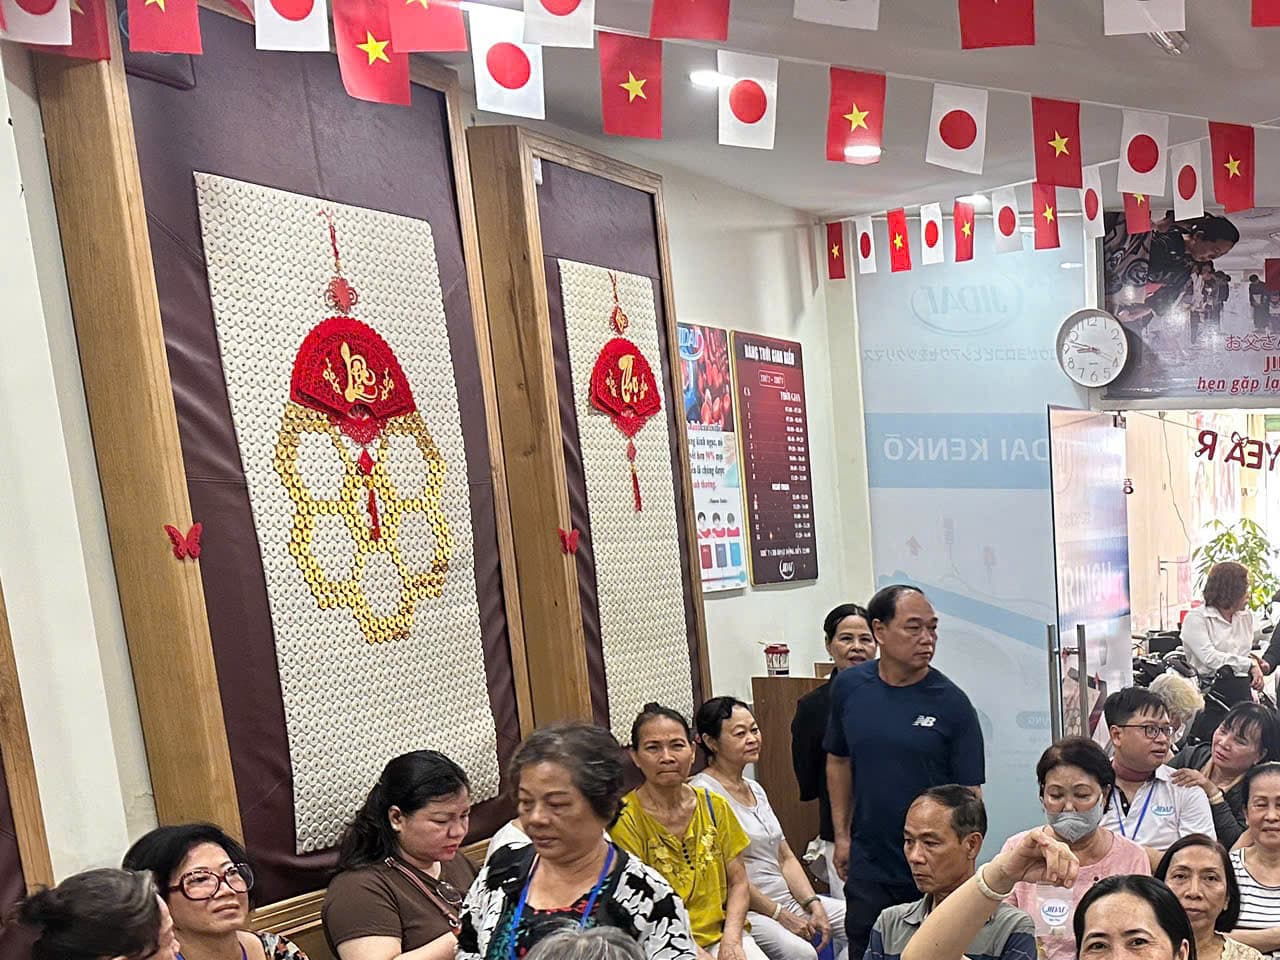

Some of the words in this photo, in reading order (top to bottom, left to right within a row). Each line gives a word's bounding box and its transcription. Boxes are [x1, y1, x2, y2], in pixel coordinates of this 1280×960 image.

[677, 327, 701, 348] IDAI
[1197, 376, 1226, 394] hẹn
[1231, 376, 1259, 394] gặp
[912, 714, 937, 727] NB
